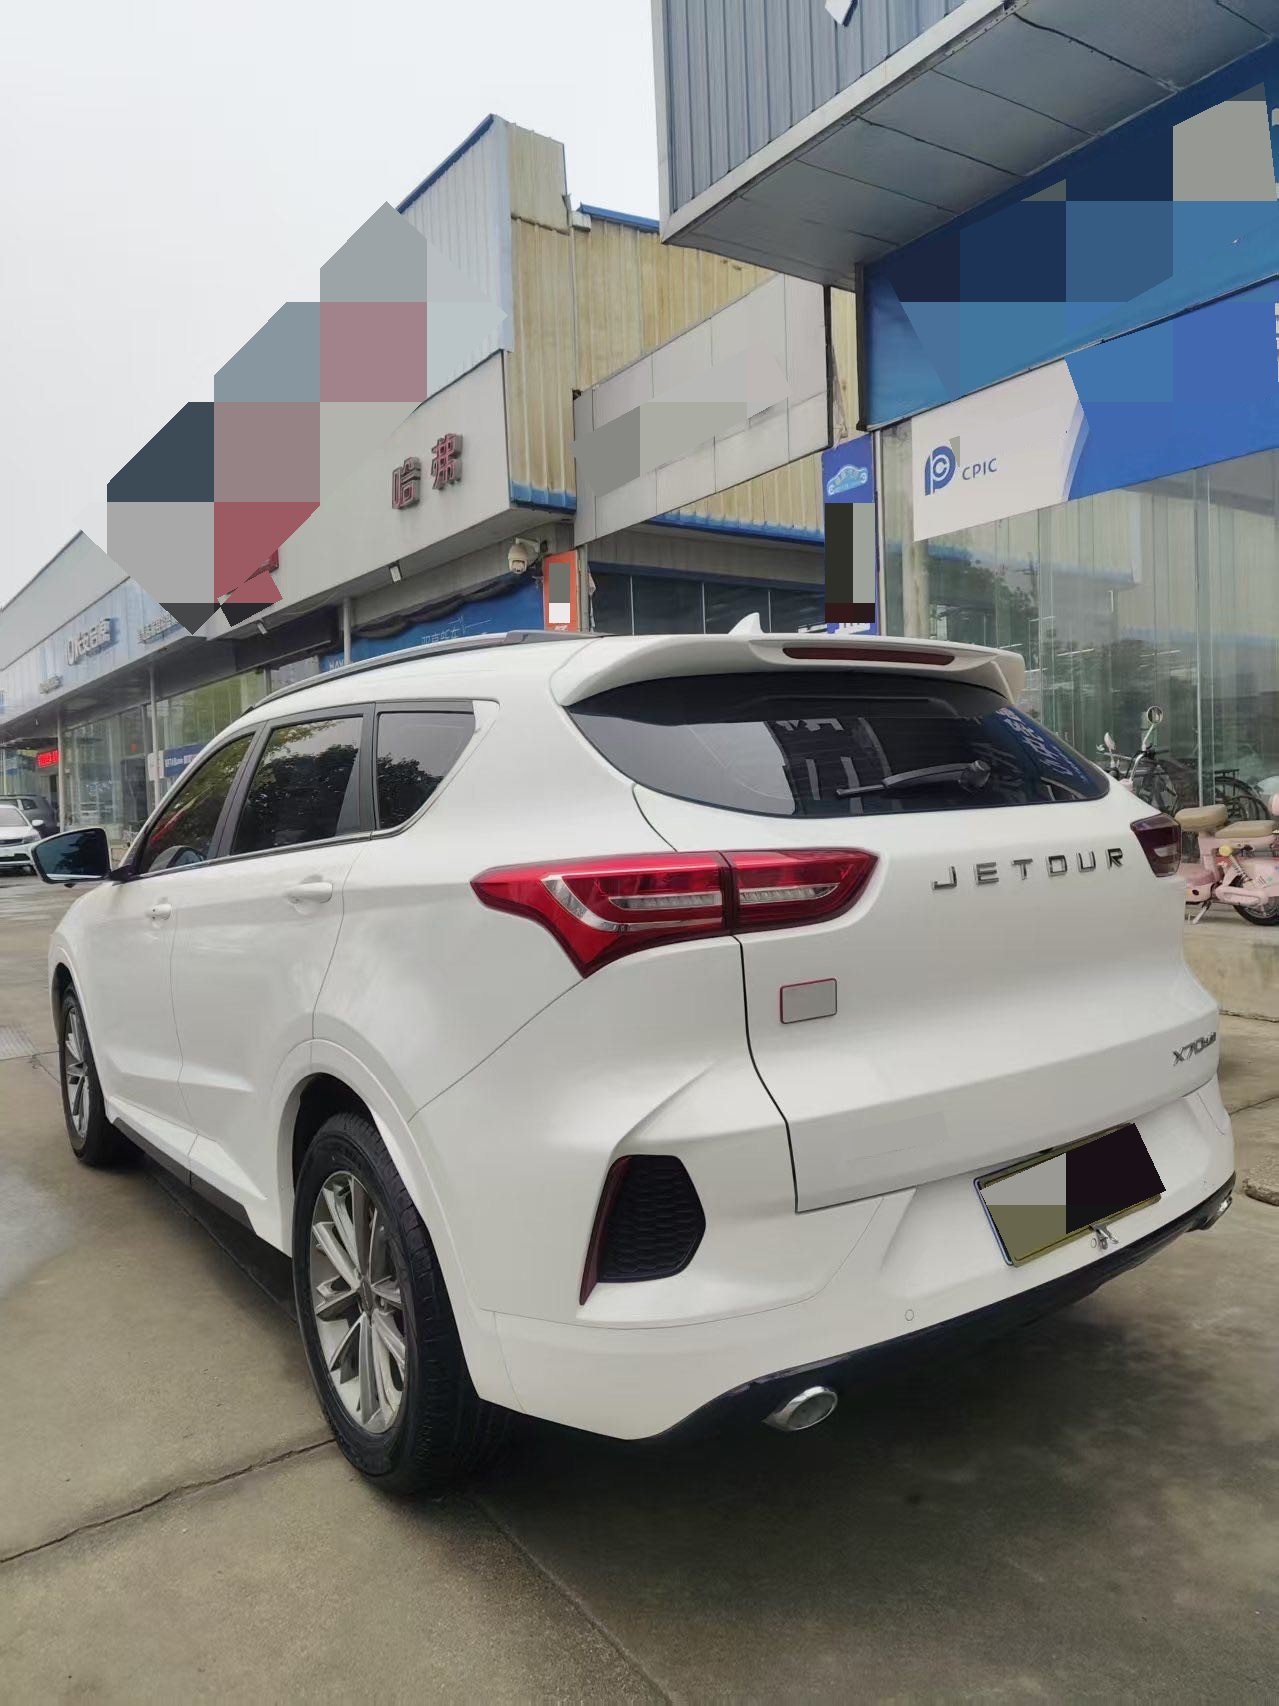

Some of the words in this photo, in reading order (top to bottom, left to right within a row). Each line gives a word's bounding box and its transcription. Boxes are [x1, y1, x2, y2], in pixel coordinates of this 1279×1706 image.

[392, 433, 462, 509] 哈弗
[962, 458, 997, 481] CPIC
[932, 847, 1124, 890] JETOUR
